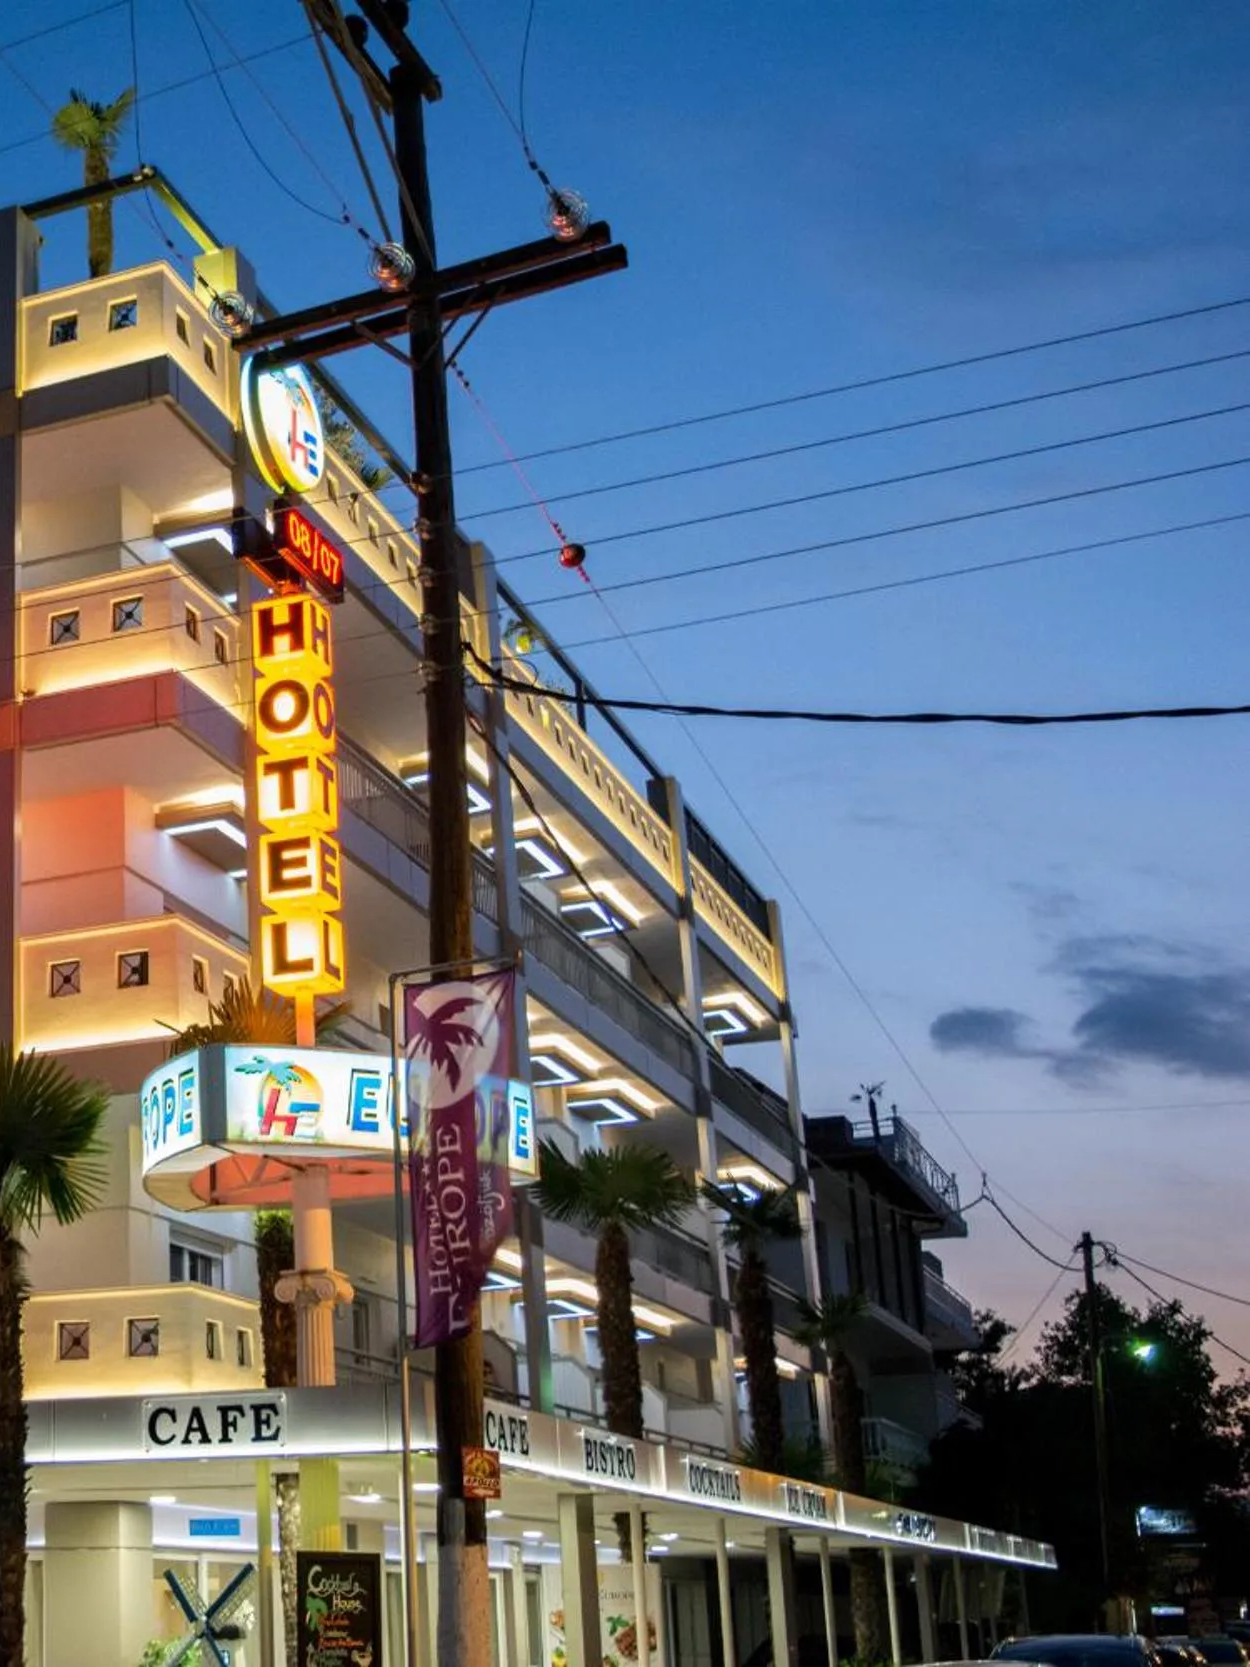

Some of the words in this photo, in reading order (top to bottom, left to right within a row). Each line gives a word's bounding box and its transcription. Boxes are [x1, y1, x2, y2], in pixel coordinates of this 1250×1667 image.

[289, 512, 342, 586] 08/07
[258, 602, 315, 979] HOTEL
[429, 1194, 452, 1297] HOTEL
[147, 1402, 282, 1446] CAFE
[485, 1409, 530, 1455] CAFE
[584, 1438, 637, 1481] BISTRO
[689, 1462, 741, 1502] COCKTAILS
